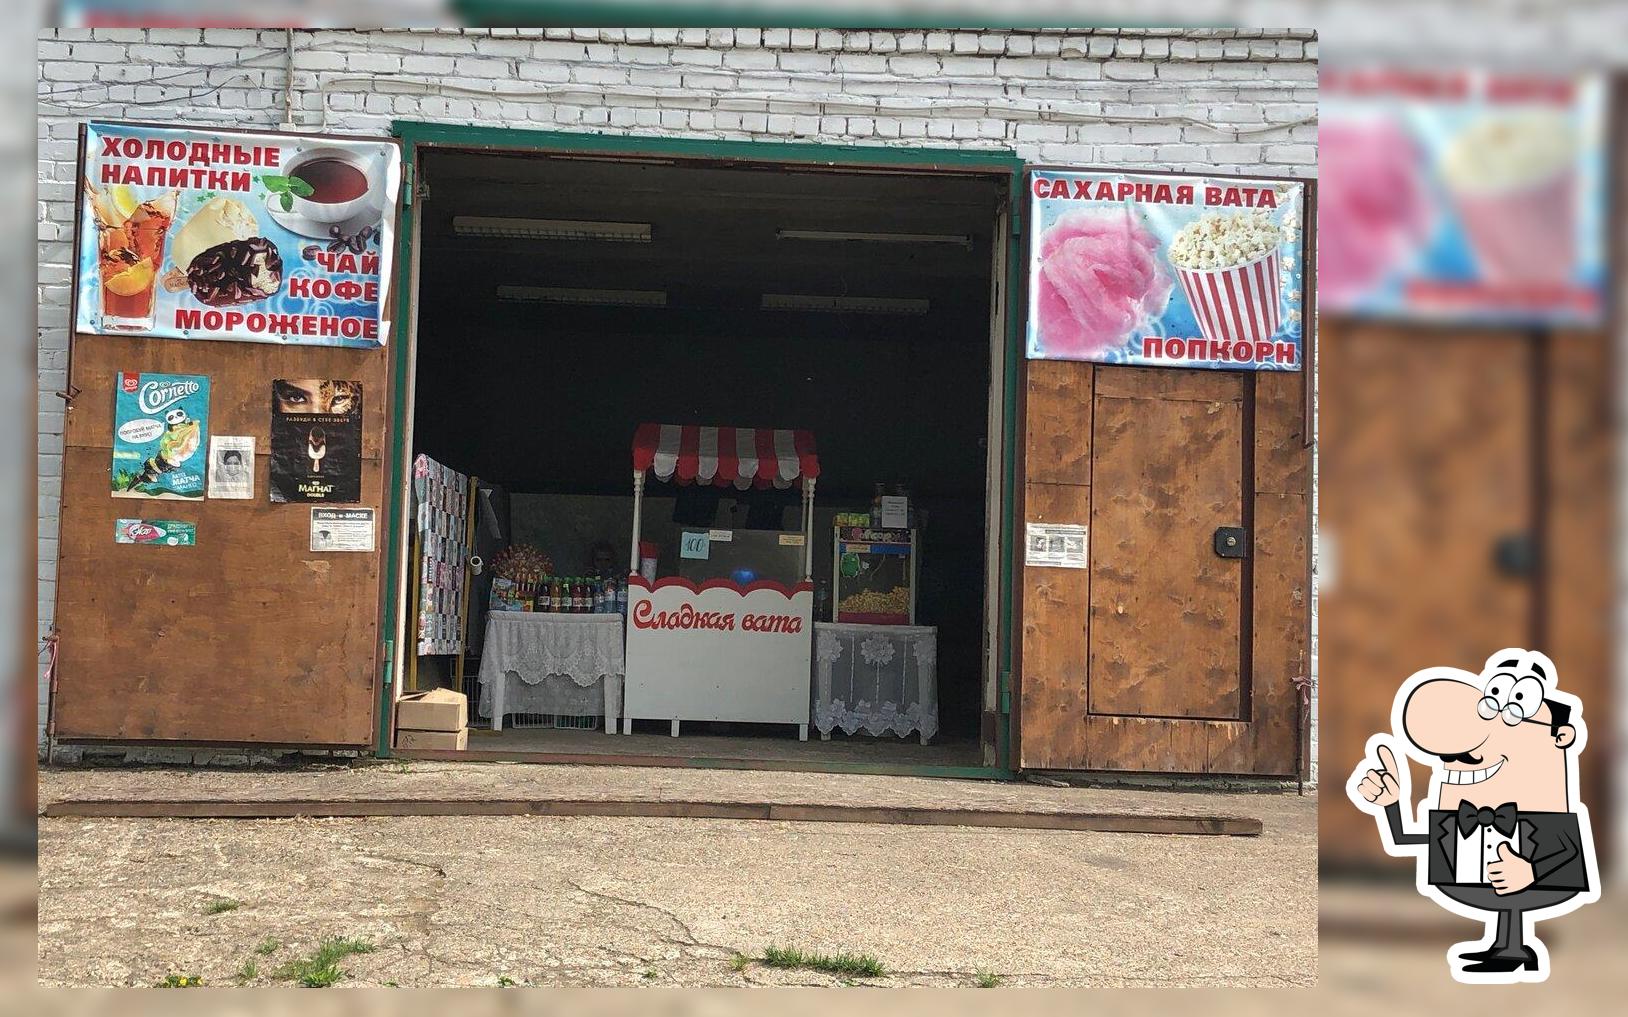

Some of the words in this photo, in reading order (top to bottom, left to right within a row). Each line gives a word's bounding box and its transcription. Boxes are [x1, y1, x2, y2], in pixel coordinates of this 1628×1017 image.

[101, 137, 281, 167] ХОЛОДНЫЕ
[101, 164, 251, 192] НАПИТКИ
[1034, 179, 1194, 205] САХАРНАЯ
[1205, 187, 1278, 209] ВАТА
[317, 251, 379, 275] ЧАЙ
[290, 278, 379, 301] КОФЕ
[175, 310, 379, 340] МОРОЖЕНОЕ
[1143, 337, 1296, 364] ПОПКОРН
[139, 381, 200, 415] Cornetto
[318, 512, 337, 520] ВХОД
[633, 599, 736, 631] Сладкая
[741, 613, 803, 633] вата
